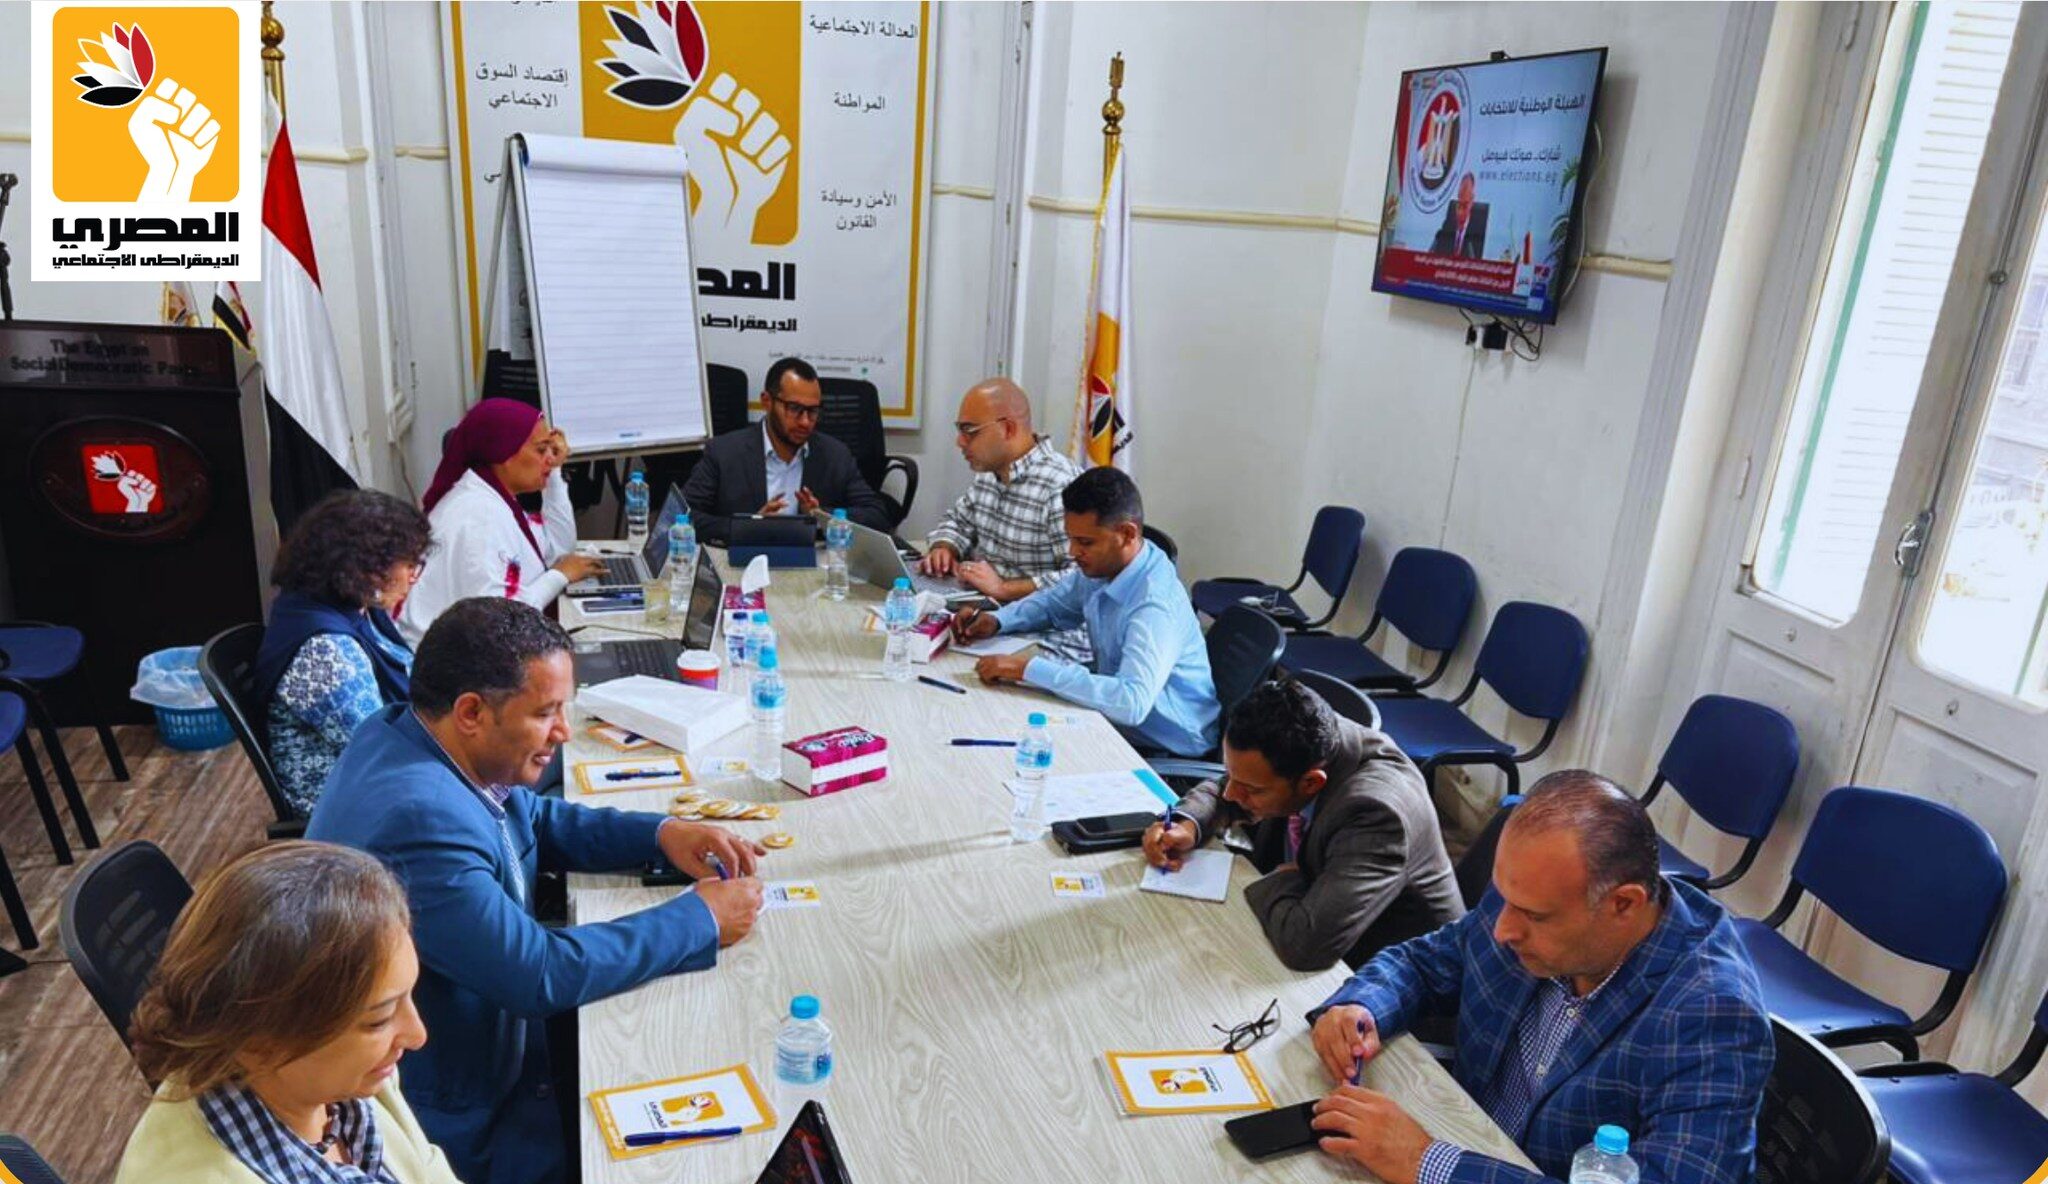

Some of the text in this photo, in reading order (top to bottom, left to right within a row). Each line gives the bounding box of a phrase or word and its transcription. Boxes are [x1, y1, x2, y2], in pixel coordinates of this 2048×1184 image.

[810, 15, 918, 38] العدالة الاجتماعية
[476, 62, 517, 81] السوق
[834, 92, 885, 113] المواطنة
[866, 190, 897, 208] الأمن
[836, 214, 877, 231] القانون
[697, 262, 796, 300] المص
